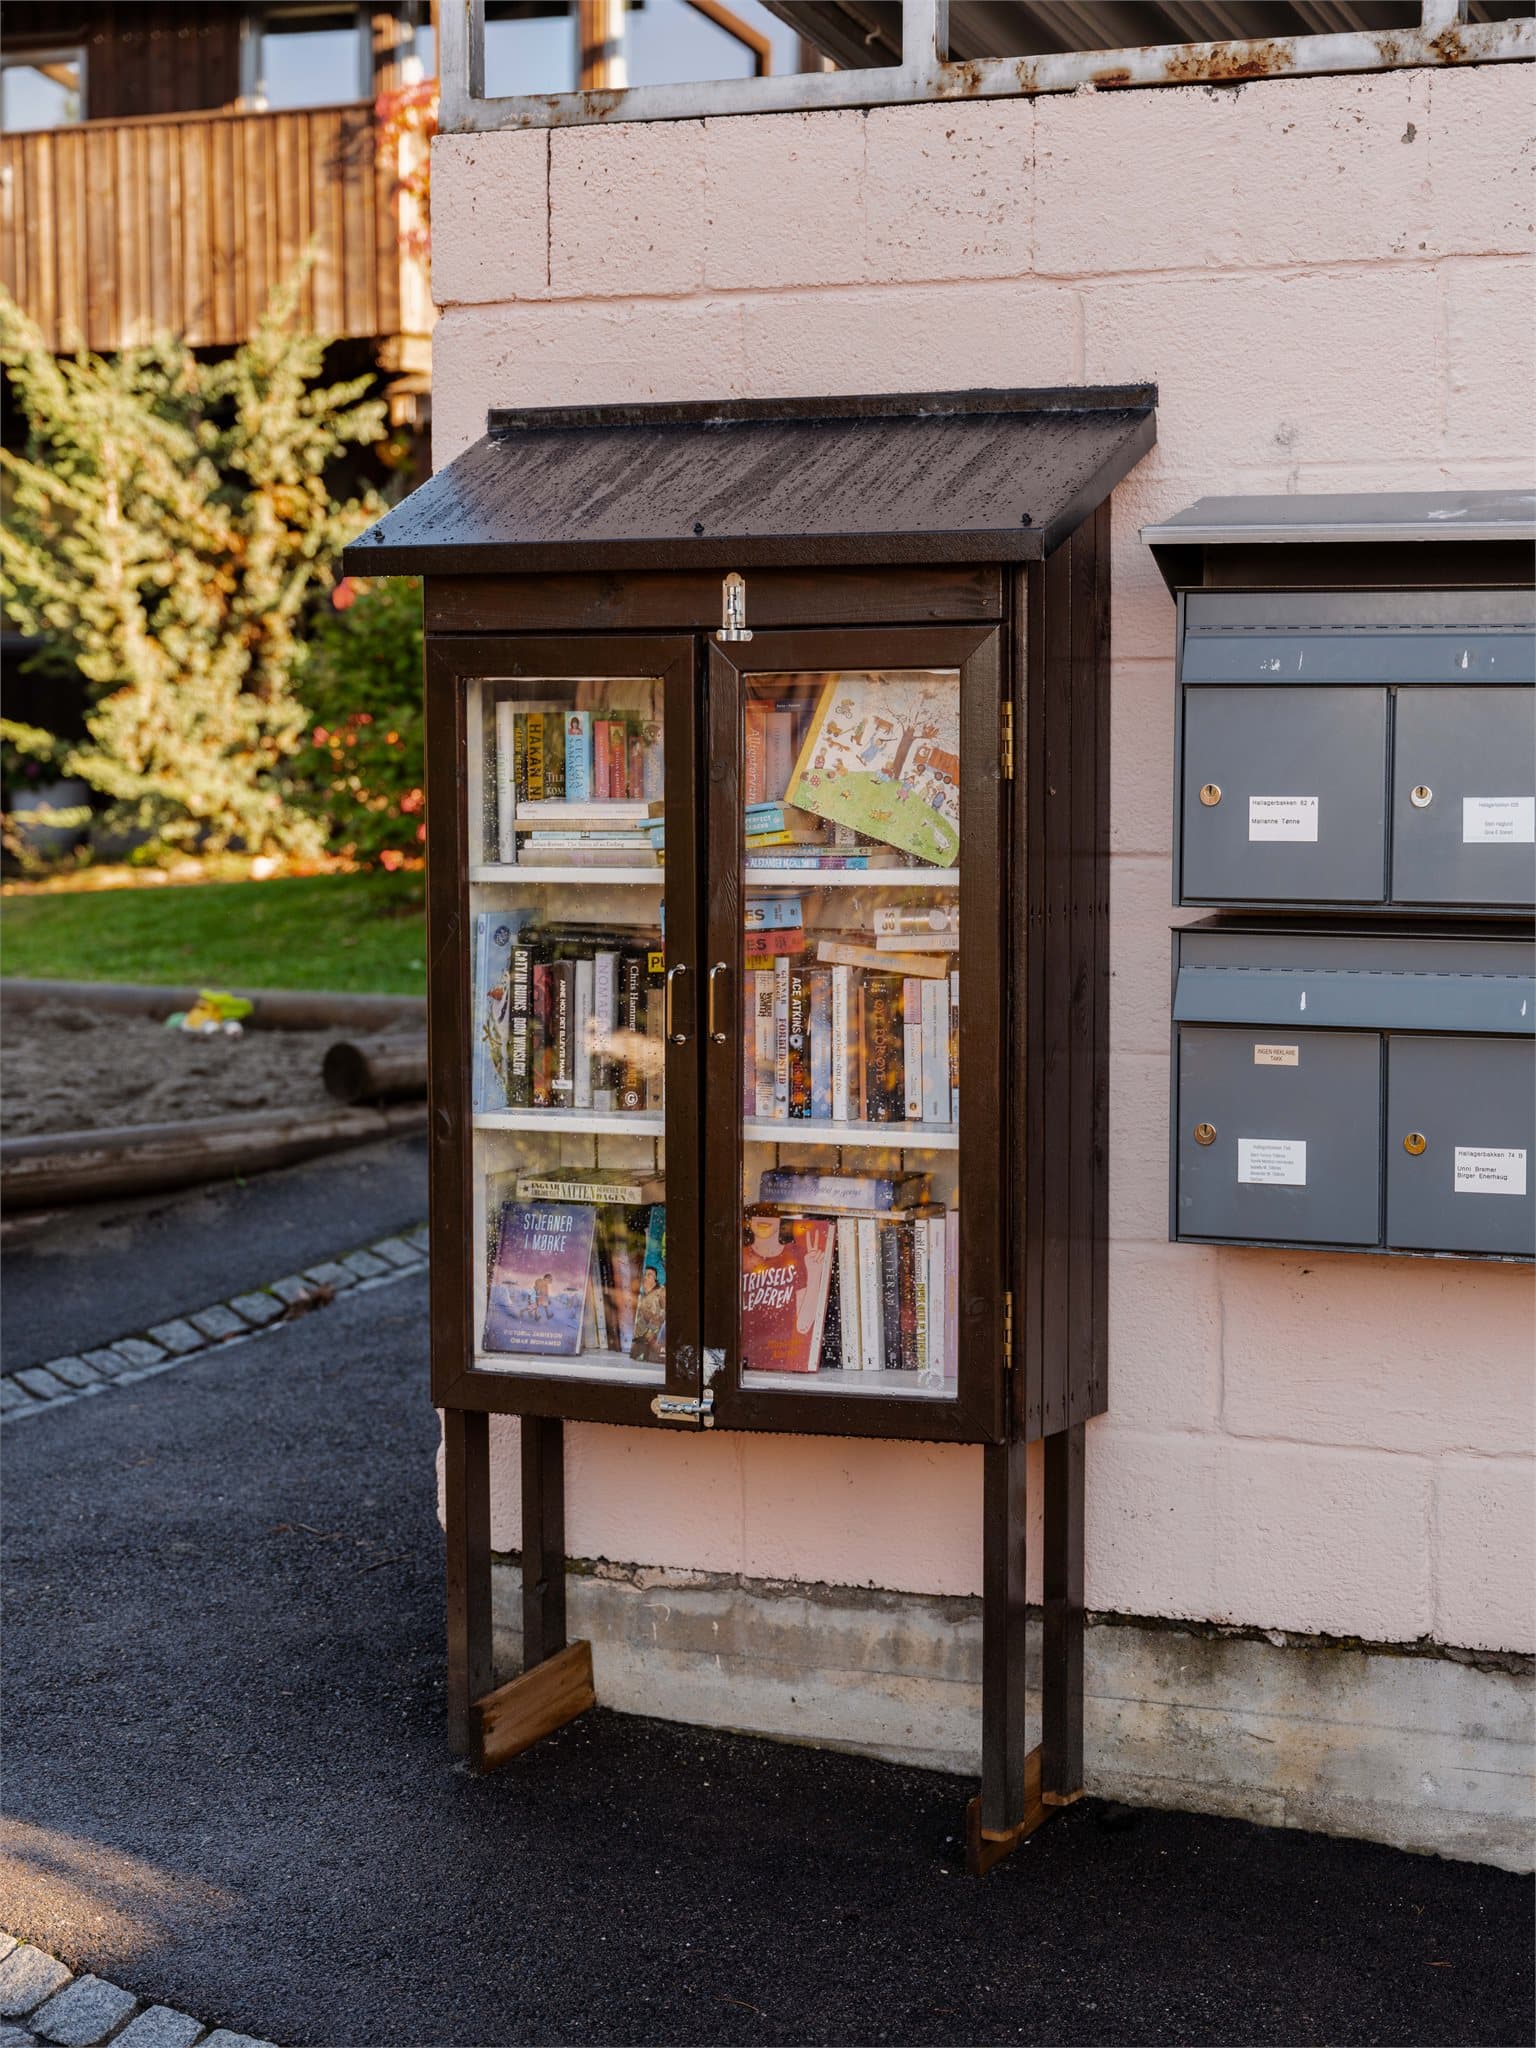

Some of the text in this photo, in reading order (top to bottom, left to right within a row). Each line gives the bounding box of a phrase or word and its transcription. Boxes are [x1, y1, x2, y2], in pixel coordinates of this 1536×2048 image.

[629, 965, 639, 990] Chris
[513, 984, 528, 1011] RUINS
[792, 977, 802, 1034] ACE ATKINS
[629, 992, 639, 1032] Hammer
[513, 1017, 527, 1035] DON
[875, 1028, 887, 1056] FOR
[512, 1036, 527, 1076] WINSLOW
[524, 1213, 573, 1233] STJERNER
[532, 1235, 567, 1252] MØRKE
